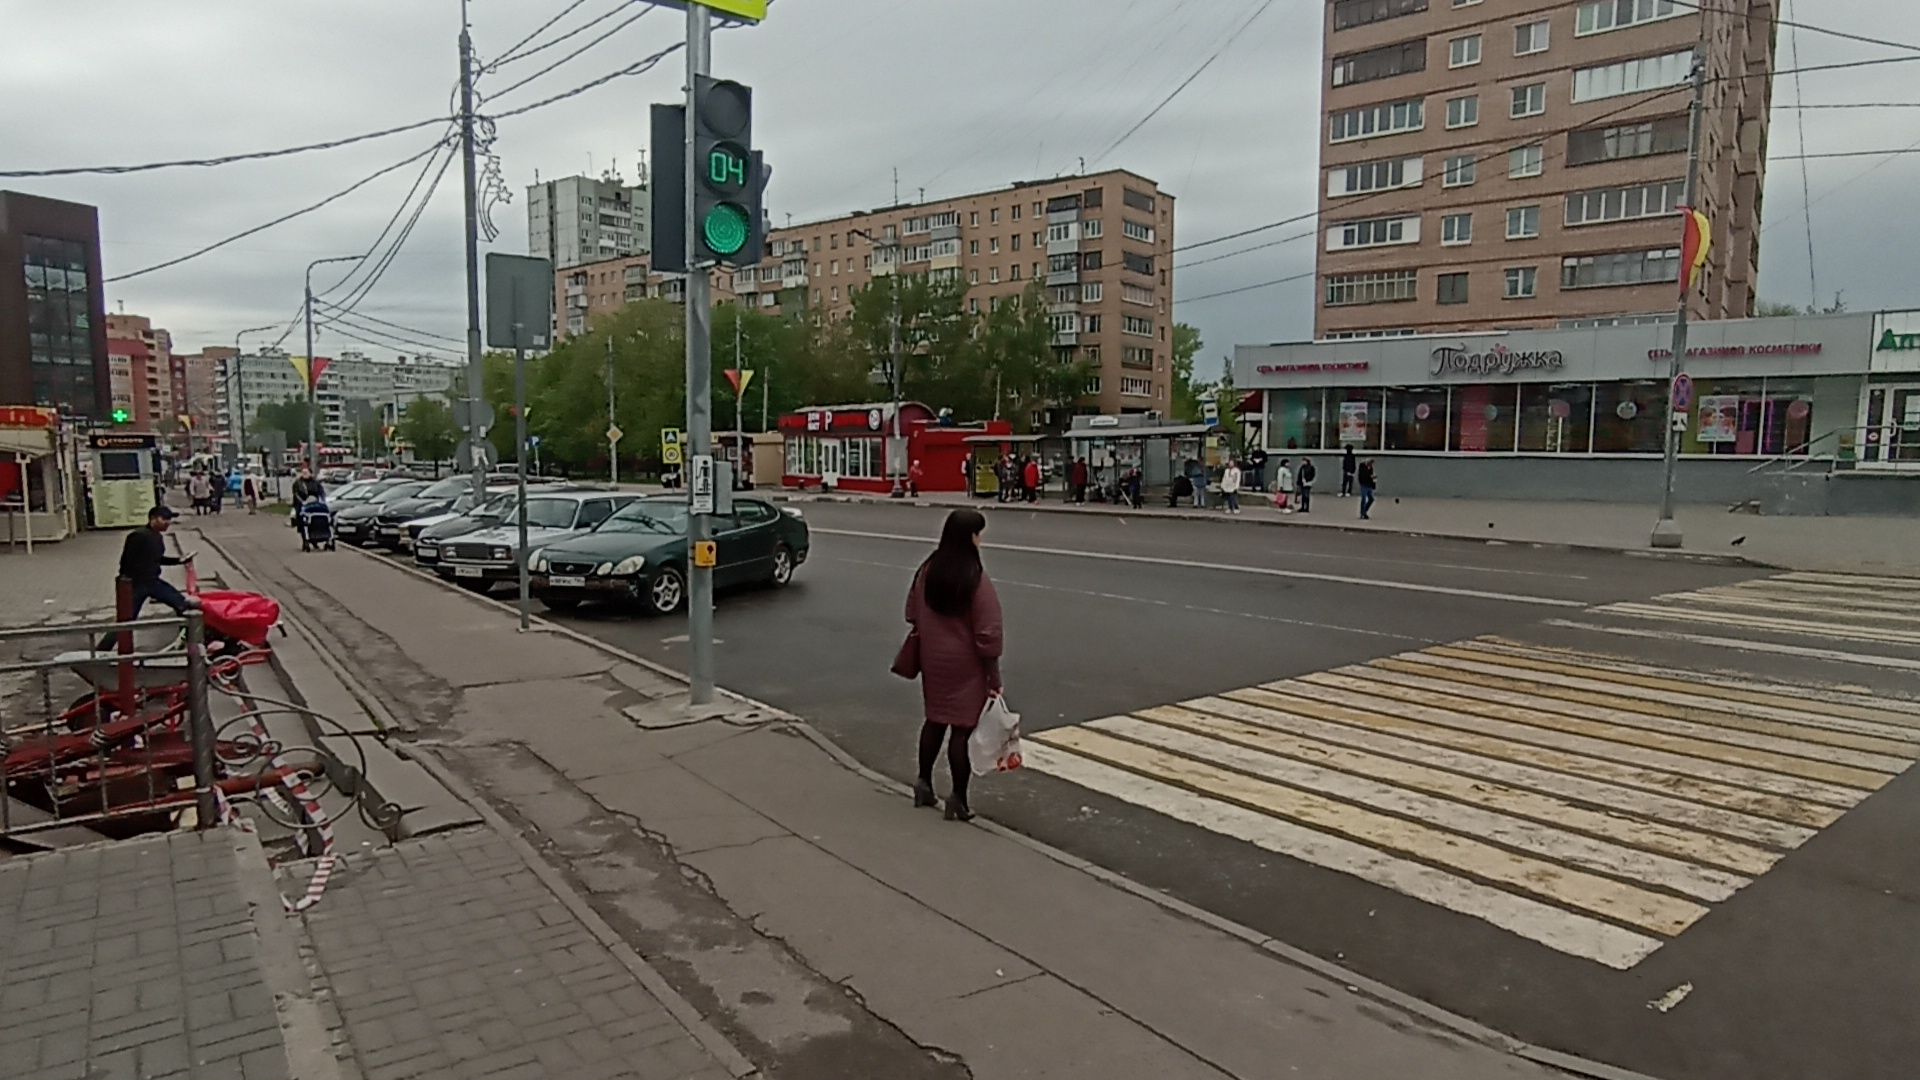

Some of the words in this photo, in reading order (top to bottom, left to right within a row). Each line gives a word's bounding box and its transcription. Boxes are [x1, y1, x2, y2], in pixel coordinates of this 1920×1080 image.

[711, 152, 743, 185] 04
[1431, 343, 1563, 376] Подружка
[1648, 349, 1673, 361] СЕТЬ
[1684, 345, 1745, 358] АГАЗИНОВ
[1749, 343, 1823, 355] КОСМЕТИКИ
